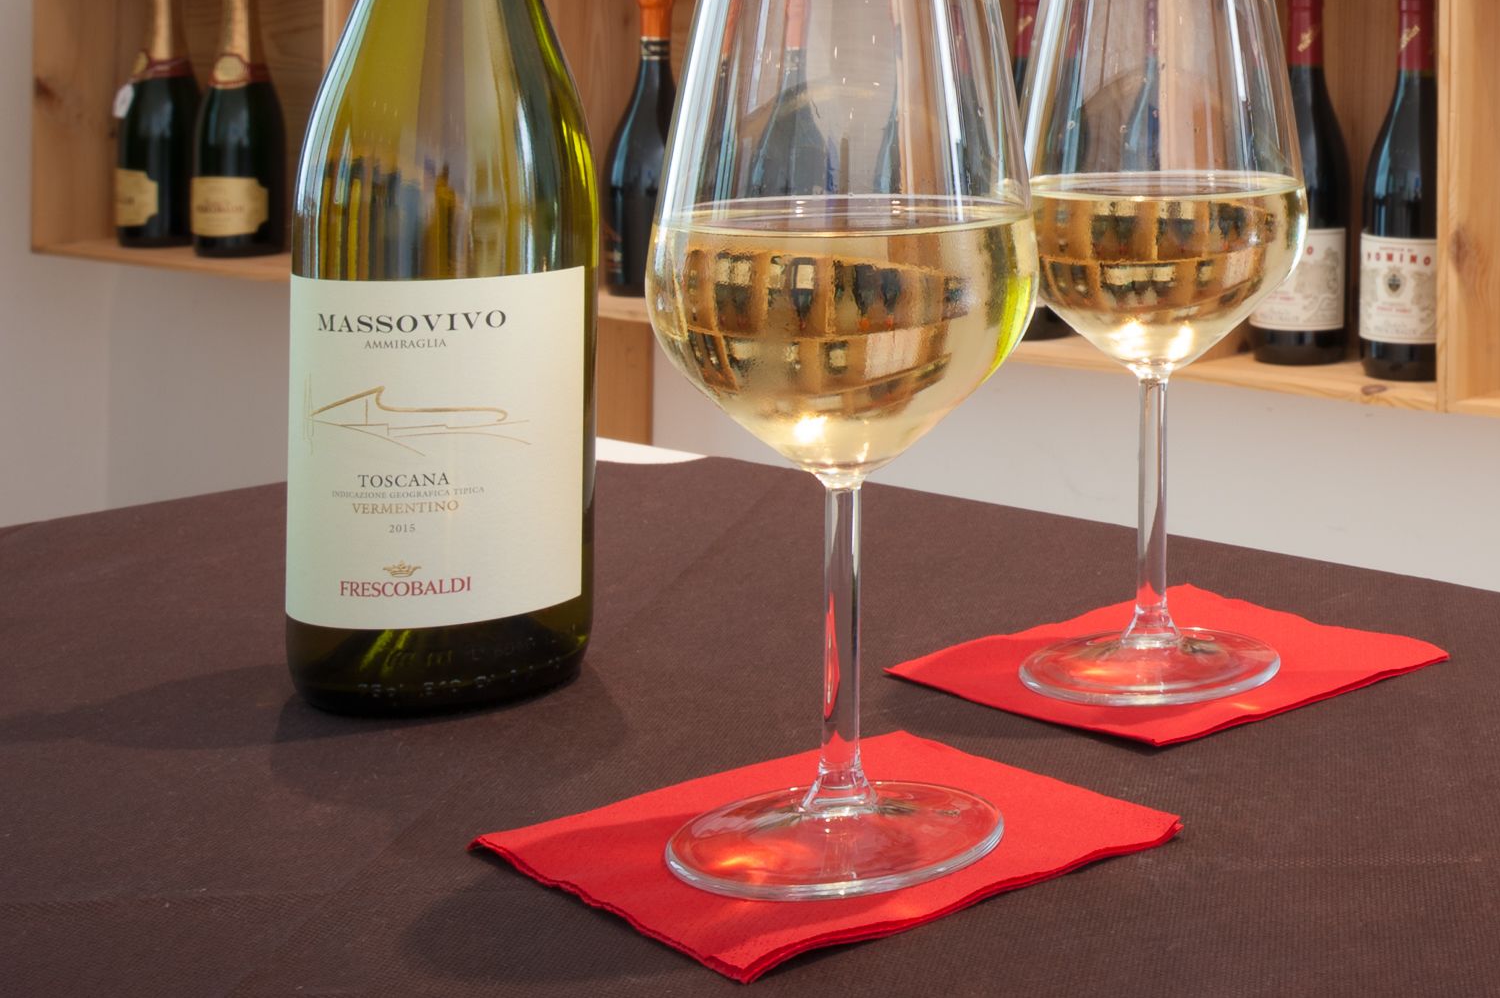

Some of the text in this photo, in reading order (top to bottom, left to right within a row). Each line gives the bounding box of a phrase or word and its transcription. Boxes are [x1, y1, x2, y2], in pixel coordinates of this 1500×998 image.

[317, 309, 507, 334] MASSOVIVO
[364, 338, 447, 350] AMMIRAGLIA
[357, 472, 450, 489] TOSCANA
[331, 486, 485, 500] INDICAZIONE GEOGRAFICA TIPICA
[351, 500, 460, 515] VERMENTINO
[388, 523, 416, 534] 2015
[340, 576, 472, 598] FRESCOBALDI
